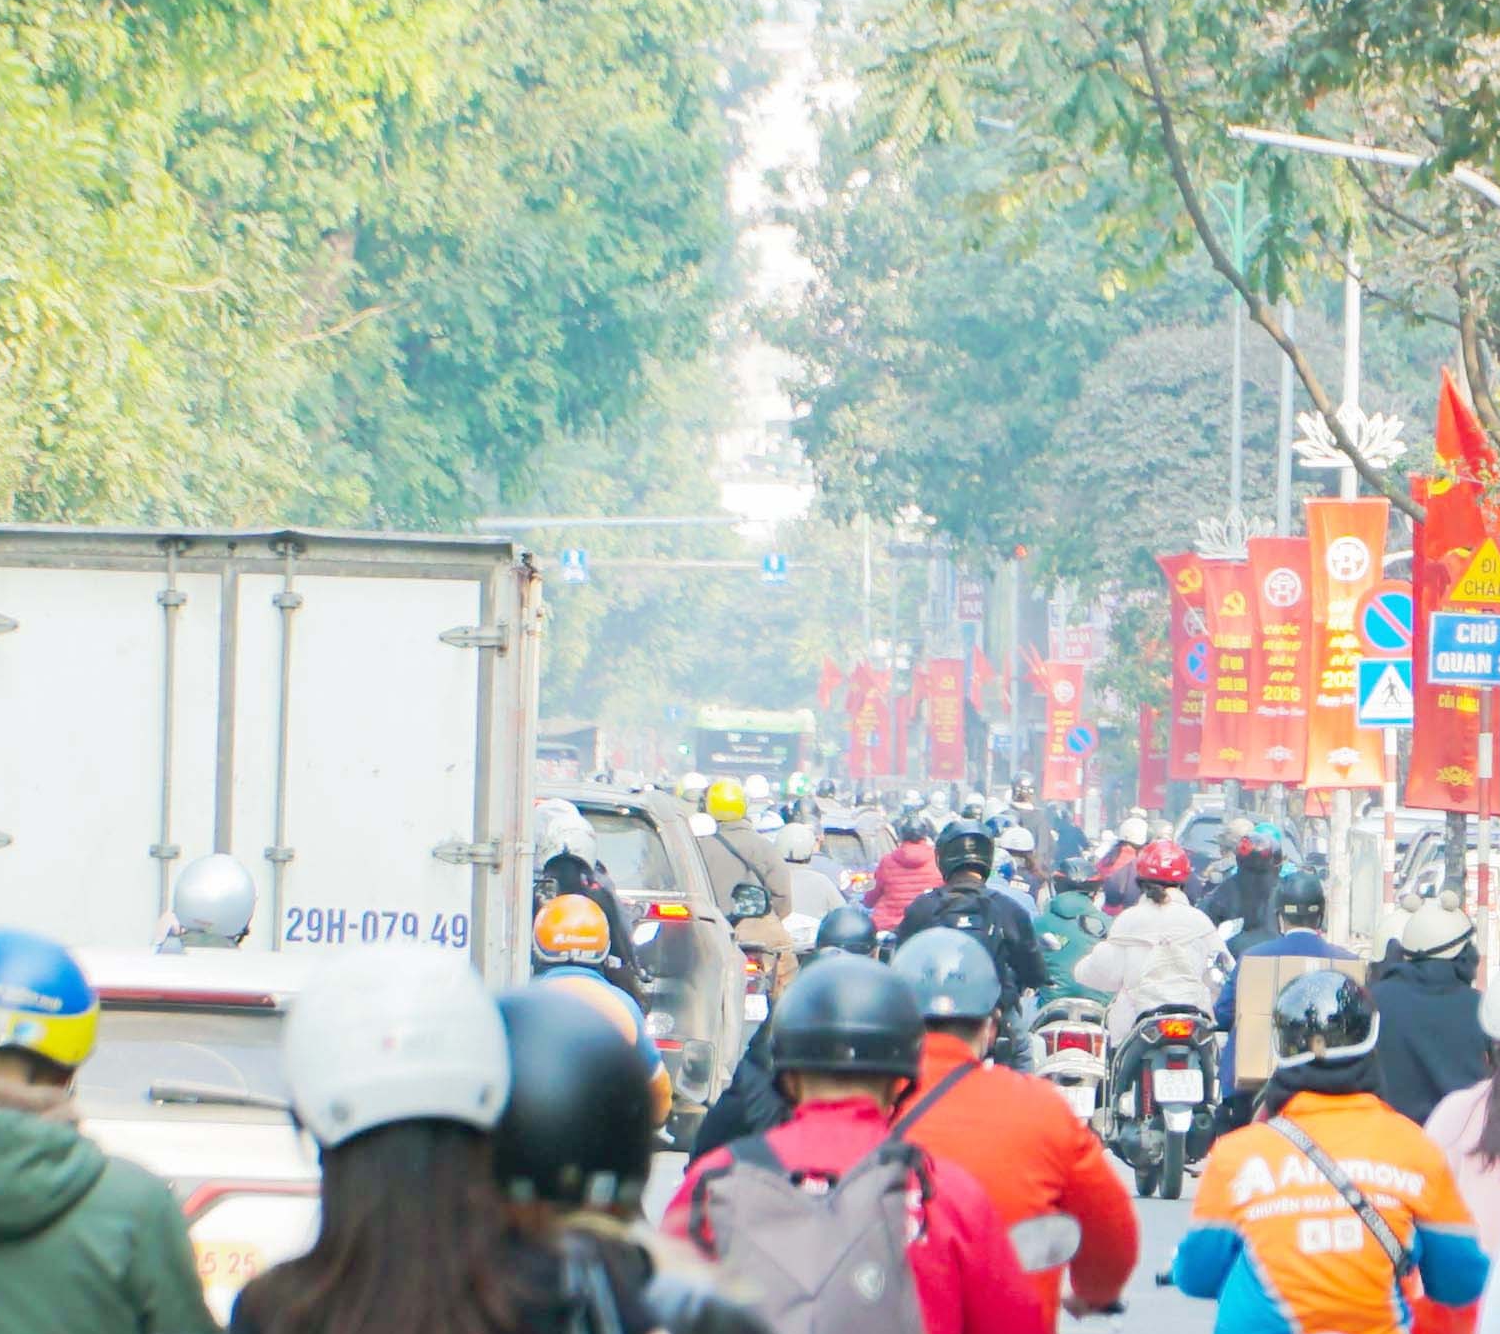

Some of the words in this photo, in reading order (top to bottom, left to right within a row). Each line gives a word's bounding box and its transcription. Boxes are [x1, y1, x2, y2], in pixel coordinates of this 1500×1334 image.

[1481, 558, 1497, 574] ĐI
[1456, 620, 1498, 645] CHÚ
[1437, 651, 1493, 675] QUAN
[1263, 685, 1301, 702] 2026
